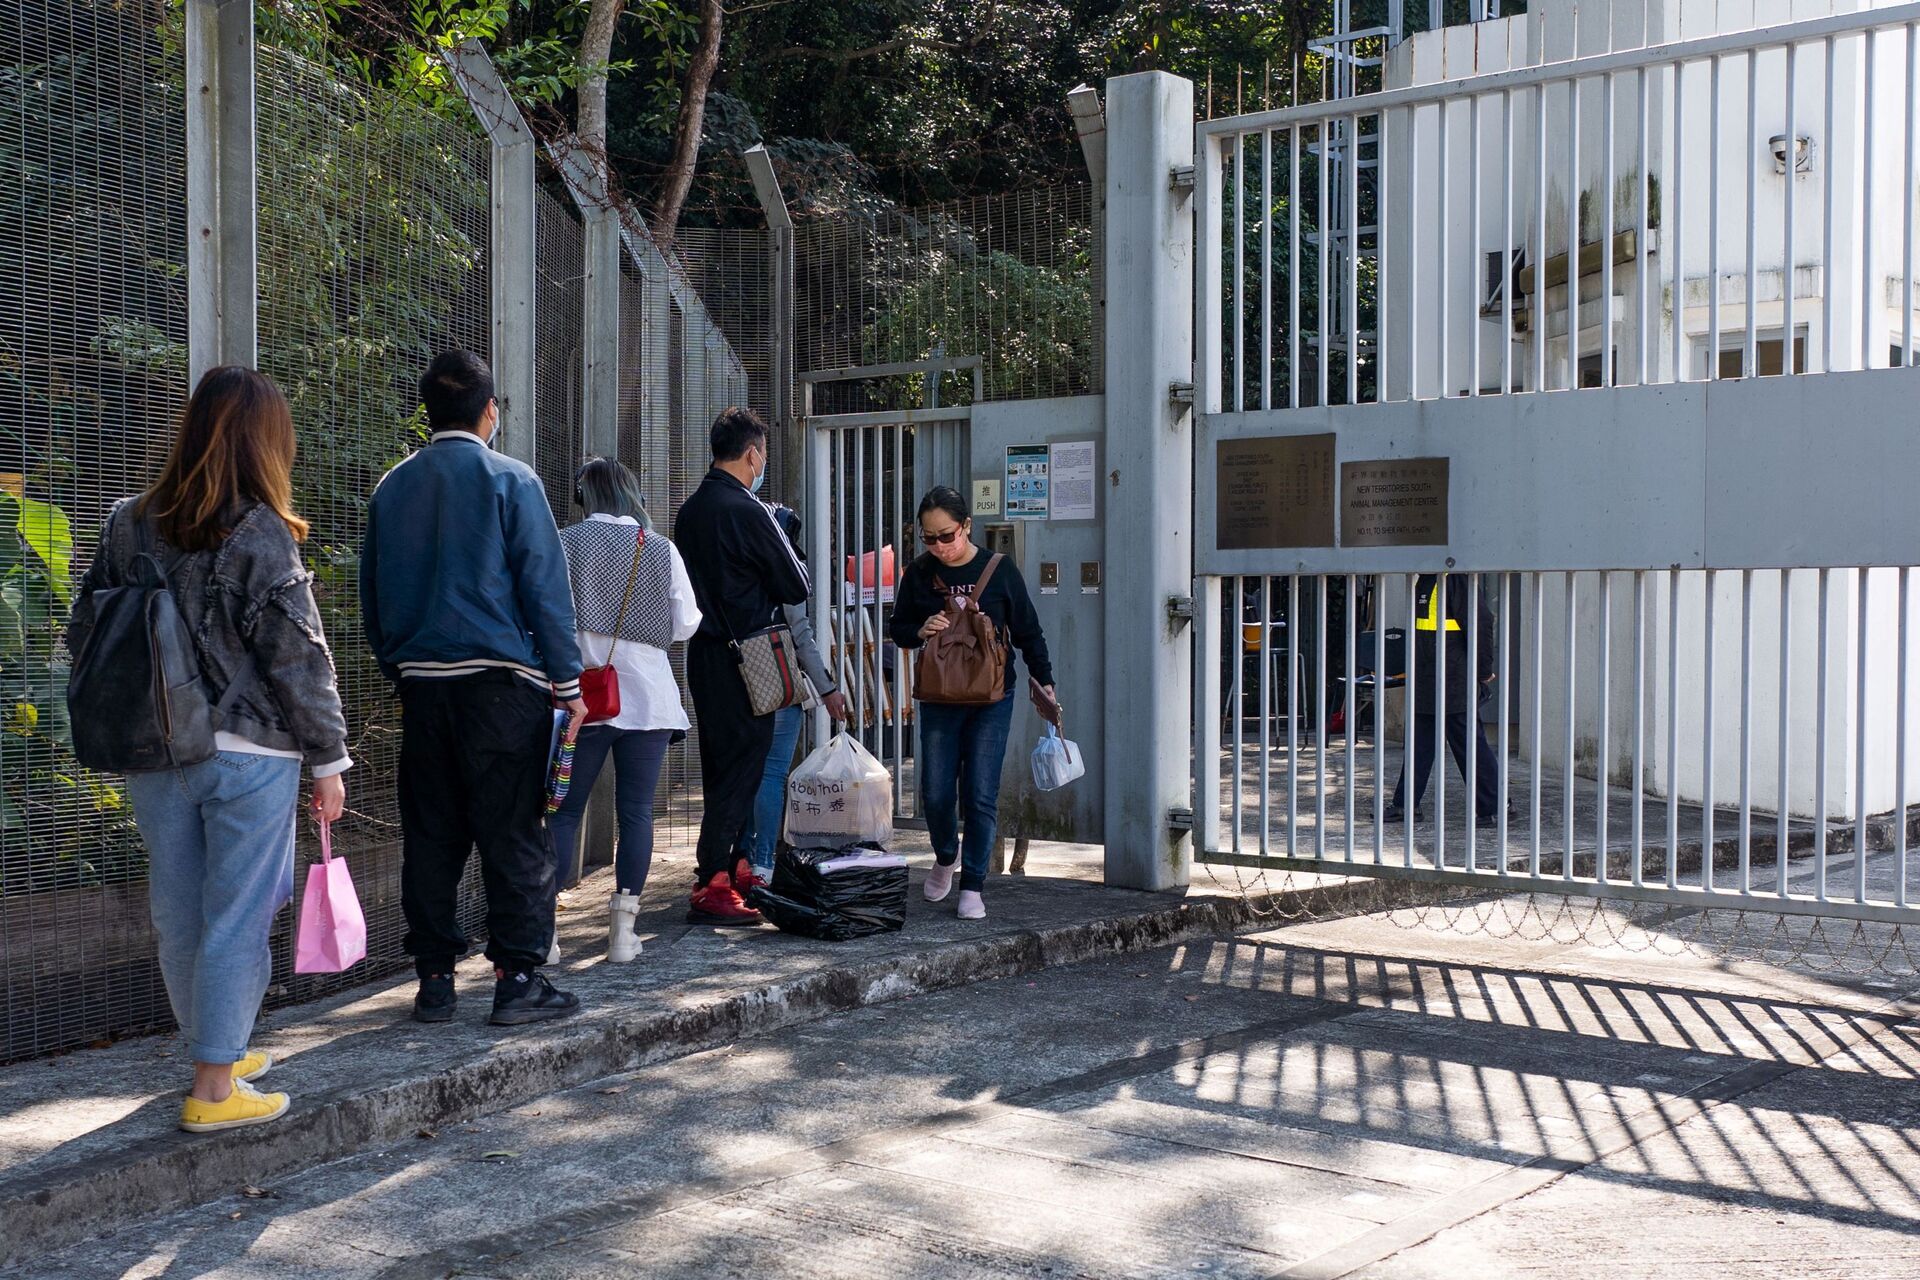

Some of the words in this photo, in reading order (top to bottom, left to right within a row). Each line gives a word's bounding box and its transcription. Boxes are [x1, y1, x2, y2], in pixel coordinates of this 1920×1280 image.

[982, 485, 991, 497] 推
[1357, 486, 1370, 494] NEW
[1371, 483, 1409, 493] TERRITORIES
[1411, 483, 1431, 491] SOUTH
[976, 501, 996, 510] PUSH
[1351, 500, 1370, 508] ANIMAL
[1371, 497, 1413, 507] MANAGEMENT
[1414, 497, 1439, 505] CENTRE
